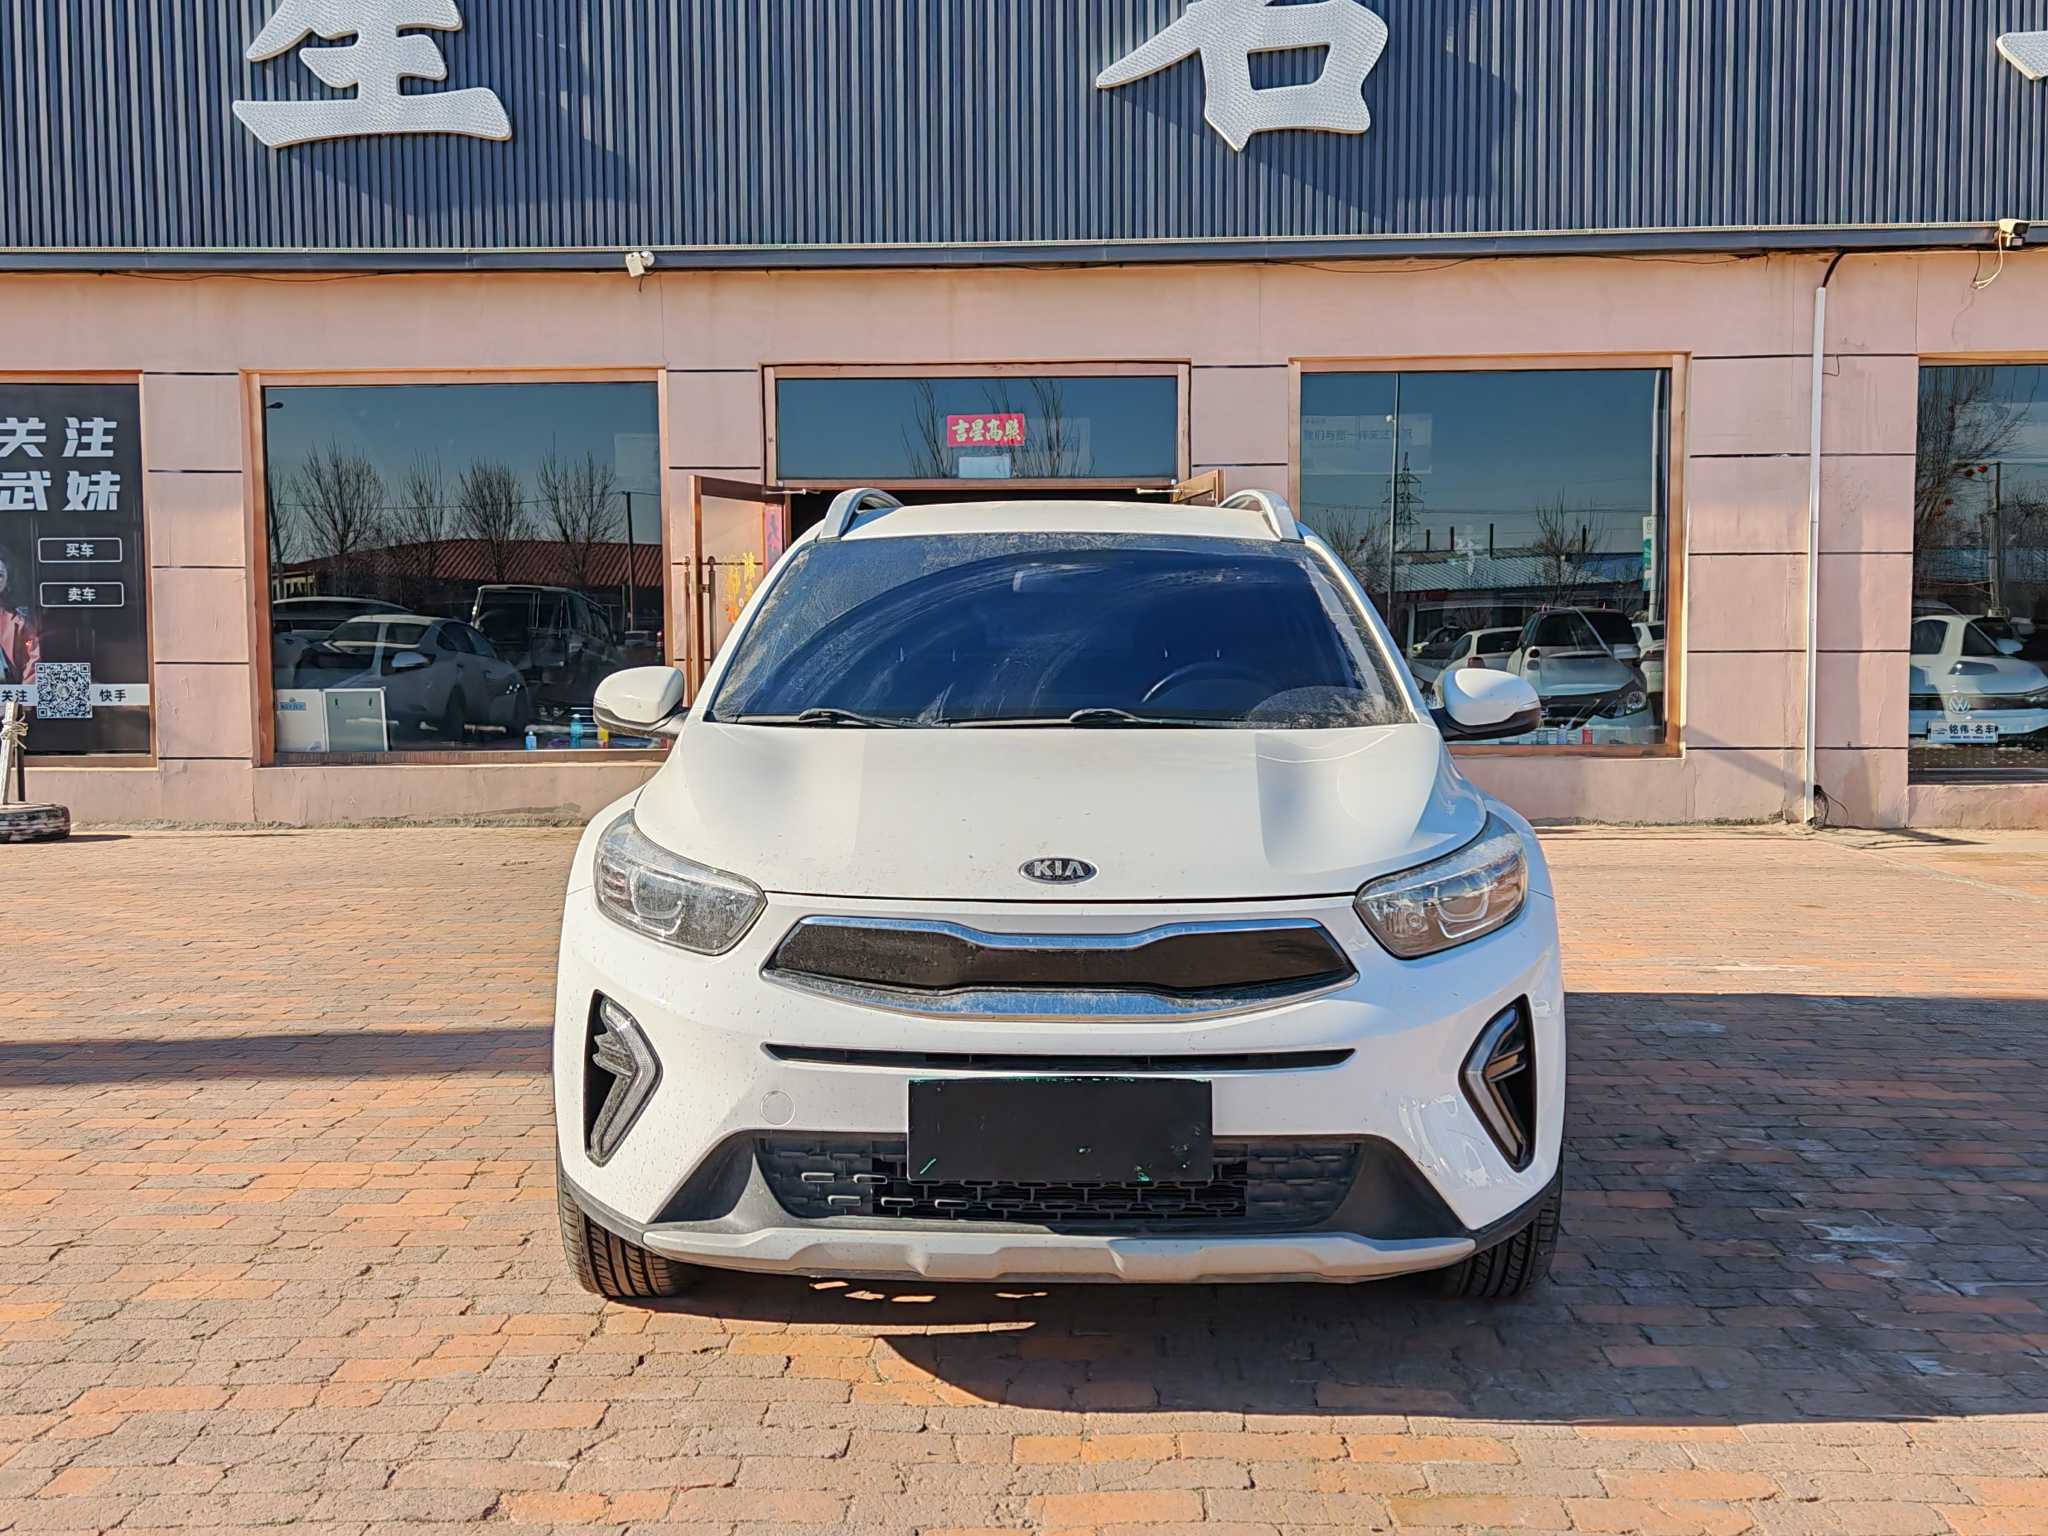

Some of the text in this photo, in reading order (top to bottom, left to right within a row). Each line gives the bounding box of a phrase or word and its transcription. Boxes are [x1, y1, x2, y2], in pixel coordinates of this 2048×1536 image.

[65, 543, 95, 557] 买车
[67, 587, 96, 602] 卖车
[99, 689, 127, 702] 快手
